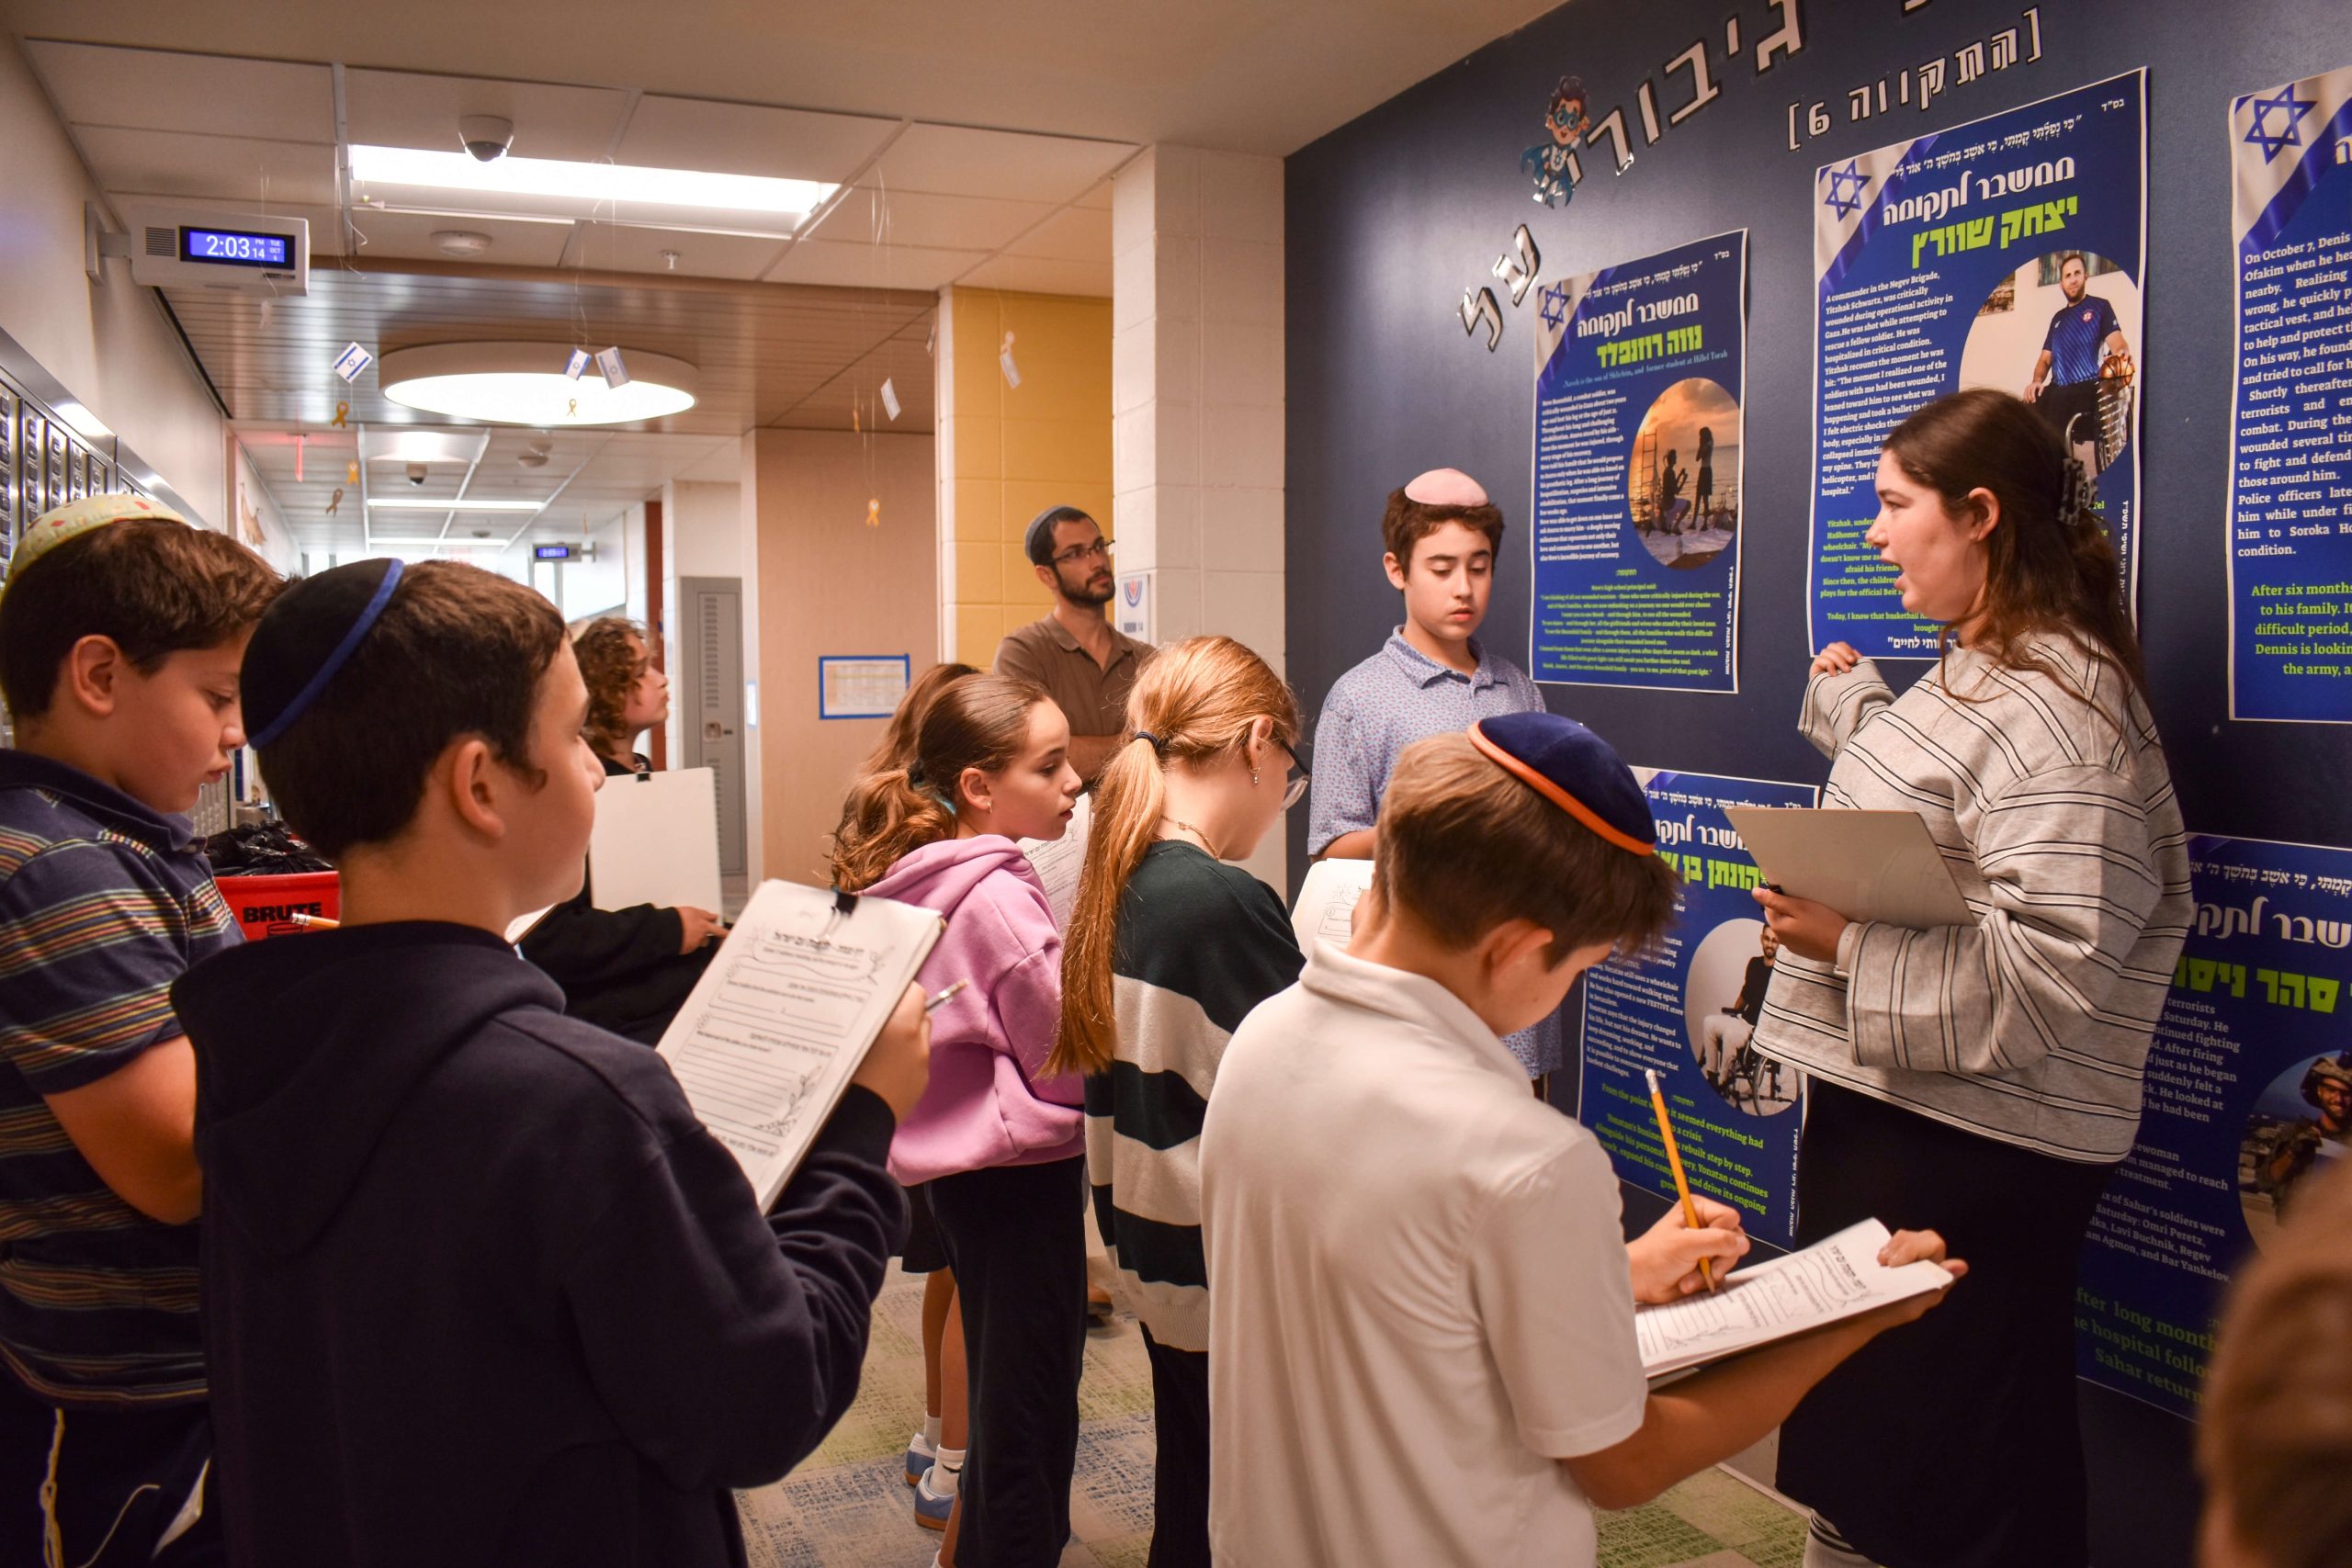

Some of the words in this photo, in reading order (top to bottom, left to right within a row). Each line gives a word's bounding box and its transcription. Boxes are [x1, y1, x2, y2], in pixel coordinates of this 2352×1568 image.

[1976, 156, 2075, 200] ממשבר
[1883, 169, 1973, 226] לתקומה
[2000, 196, 2078, 250] יצחק
[206, 235, 250, 258] 2:03
[252, 248, 266, 259] 14
[1912, 216, 1995, 269] שוורץ
[2245, 254, 2261, 265] On
[2262, 244, 2305, 260] October
[2307, 243, 2315, 253] 7,
[2318, 232, 2351, 248] Denis
[2245, 266, 2284, 281] Ofakim
[2286, 260, 2316, 273] when
[2319, 255, 2333, 265] he
[1831, 288, 1870, 301] commander
[1878, 283, 1889, 291] the
[1890, 279, 1910, 288] Negev
[1911, 272, 1940, 284] Brigade,
[2245, 284, 2282, 299] nearby.
[2296, 271, 2348, 288] Realizing
[1637, 293, 1699, 323] ממשבר
[1825, 314, 1854, 327] wounded
[1855, 310, 1876, 321] during
[1876, 301, 1916, 317] operational
[1917, 297, 1944, 308] activity
[1945, 294, 1953, 302] in
[1826, 303, 1850, 315] Yitzhak
[1850, 298, 1883, 310] Schwartz,
[1896, 287, 1928, 299] critically
[2245, 303, 2279, 316] wrong,
[2283, 298, 2297, 309] he
[2300, 289, 2341, 307] quickly
[1577, 299, 1635, 338] לתקומה
[2245, 317, 2284, 333] tactical
[2285, 313, 2311, 325] vest,
[2313, 307, 2335, 321] and
[1597, 333, 1663, 368] רוזנפלד
[1667, 325, 1702, 355] נווה
[1825, 343, 1845, 351] rescue
[1850, 337, 1871, 346] fellow
[1871, 333, 1895, 343] soldier.
[1896, 330, 1906, 338] He
[2244, 342, 2255, 351] to
[2256, 336, 2278, 348] help
[2280, 331, 2301, 344] and
[2302, 325, 2344, 343] protect
[2244, 358, 2258, 367] On
[2260, 354, 2277, 365] his
[2278, 351, 2301, 362] way,
[2303, 347, 2317, 357] he
[2319, 340, 2352, 355] found
[2243, 372, 2262, 385] and
[2263, 367, 2290, 381] tried
[2290, 368, 2302, 378] to
[2303, 362, 2325, 375] call
[2327, 361, 2344, 372] for
[2249, 387, 2288, 400] Shortly
[2241, 405, 2290, 419] terrorists
[2303, 398, 2325, 411] and
[2241, 423, 2283, 436] combat.
[2288, 418, 2328, 431] During
[2333, 414, 2352, 425] the
[2240, 438, 2289, 453] wounded
[2293, 434, 2334, 447] several
[2239, 462, 2251, 471] to
[2255, 457, 2281, 471] fight
[2286, 454, 2307, 467] and
[2312, 450, 2352, 463] defend
[2238, 478, 2268, 488] those
[2270, 471, 2311, 485] around
[2312, 470, 2340, 481] him.
[2238, 493, 2271, 505] Police
[2278, 490, 2322, 502] officers
[2238, 512, 2260, 523] him
[2265, 508, 2297, 520] while
[2302, 506, 2337, 518] under
[2237, 528, 2261, 539] him
[2268, 529, 2281, 537] to
[2290, 525, 2330, 536] Soroka
[2238, 545, 2297, 557] condition.
[2252, 585, 2283, 596] After
[2286, 583, 2303, 595] six
[2260, 606, 2273, 615] to
[2276, 604, 2294, 615] his
[2297, 603, 2341, 615] family.
[2255, 624, 2305, 635] difficult
[2256, 644, 2299, 655] Dennis
[2301, 643, 2312, 655] is
[2283, 663, 2304, 674] the
[2306, 666, 2341, 677] army,
[243, 902, 322, 923] BRUTE
[2256, 967, 2340, 1014] סהר
[2146, 1070, 2192, 1088] suddenly
[2195, 1079, 2212, 1091] felt
[2215, 1086, 2222, 1094] a
[1678, 1112, 1705, 1128] seemed
[1706, 1122, 1747, 1145] everything
[1748, 1135, 1764, 1148] had
[1682, 1127, 1703, 1143] crisis.
[1681, 1143, 1705, 1158] rebuilt
[1707, 1154, 1724, 1167] step
[1724, 1156, 1734, 1170] by
[1735, 1163, 1753, 1178] step.
[1698, 1163, 1728, 1183] Yonatan
[1729, 1178, 1769, 1198] continues
[2139, 1159, 2184, 1178] managed
[2186, 1171, 2197, 1181] to
[2199, 1176, 2228, 1190] reach
[1703, 1180, 1723, 1196] drive
[1723, 1188, 1733, 1201] its
[1734, 1195, 1767, 1215] ongoing
[2141, 1249, 2160, 1261] and
[2161, 1254, 2179, 1266] Bar
[2181, 1259, 2232, 1283] Yankelov.
[2114, 1300, 2152, 1332] long
